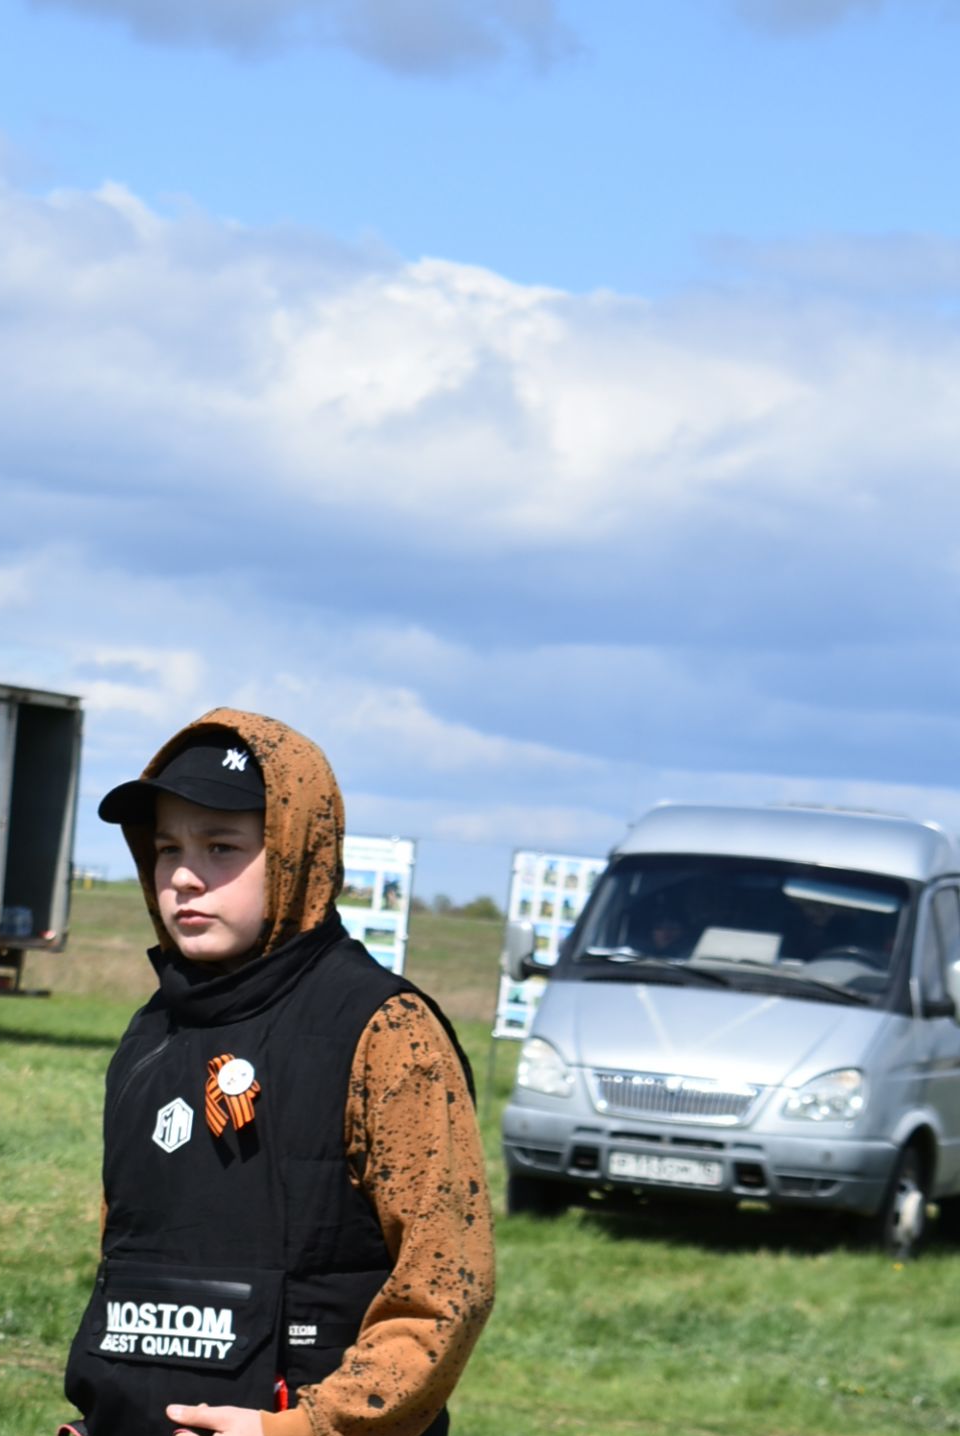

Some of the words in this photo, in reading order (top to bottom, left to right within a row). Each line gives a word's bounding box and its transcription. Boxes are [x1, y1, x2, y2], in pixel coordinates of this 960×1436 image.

[107, 1302, 234, 1336] MOSTOM
[100, 1333, 139, 1353] BEST
[142, 1335, 234, 1360] QUALITY
